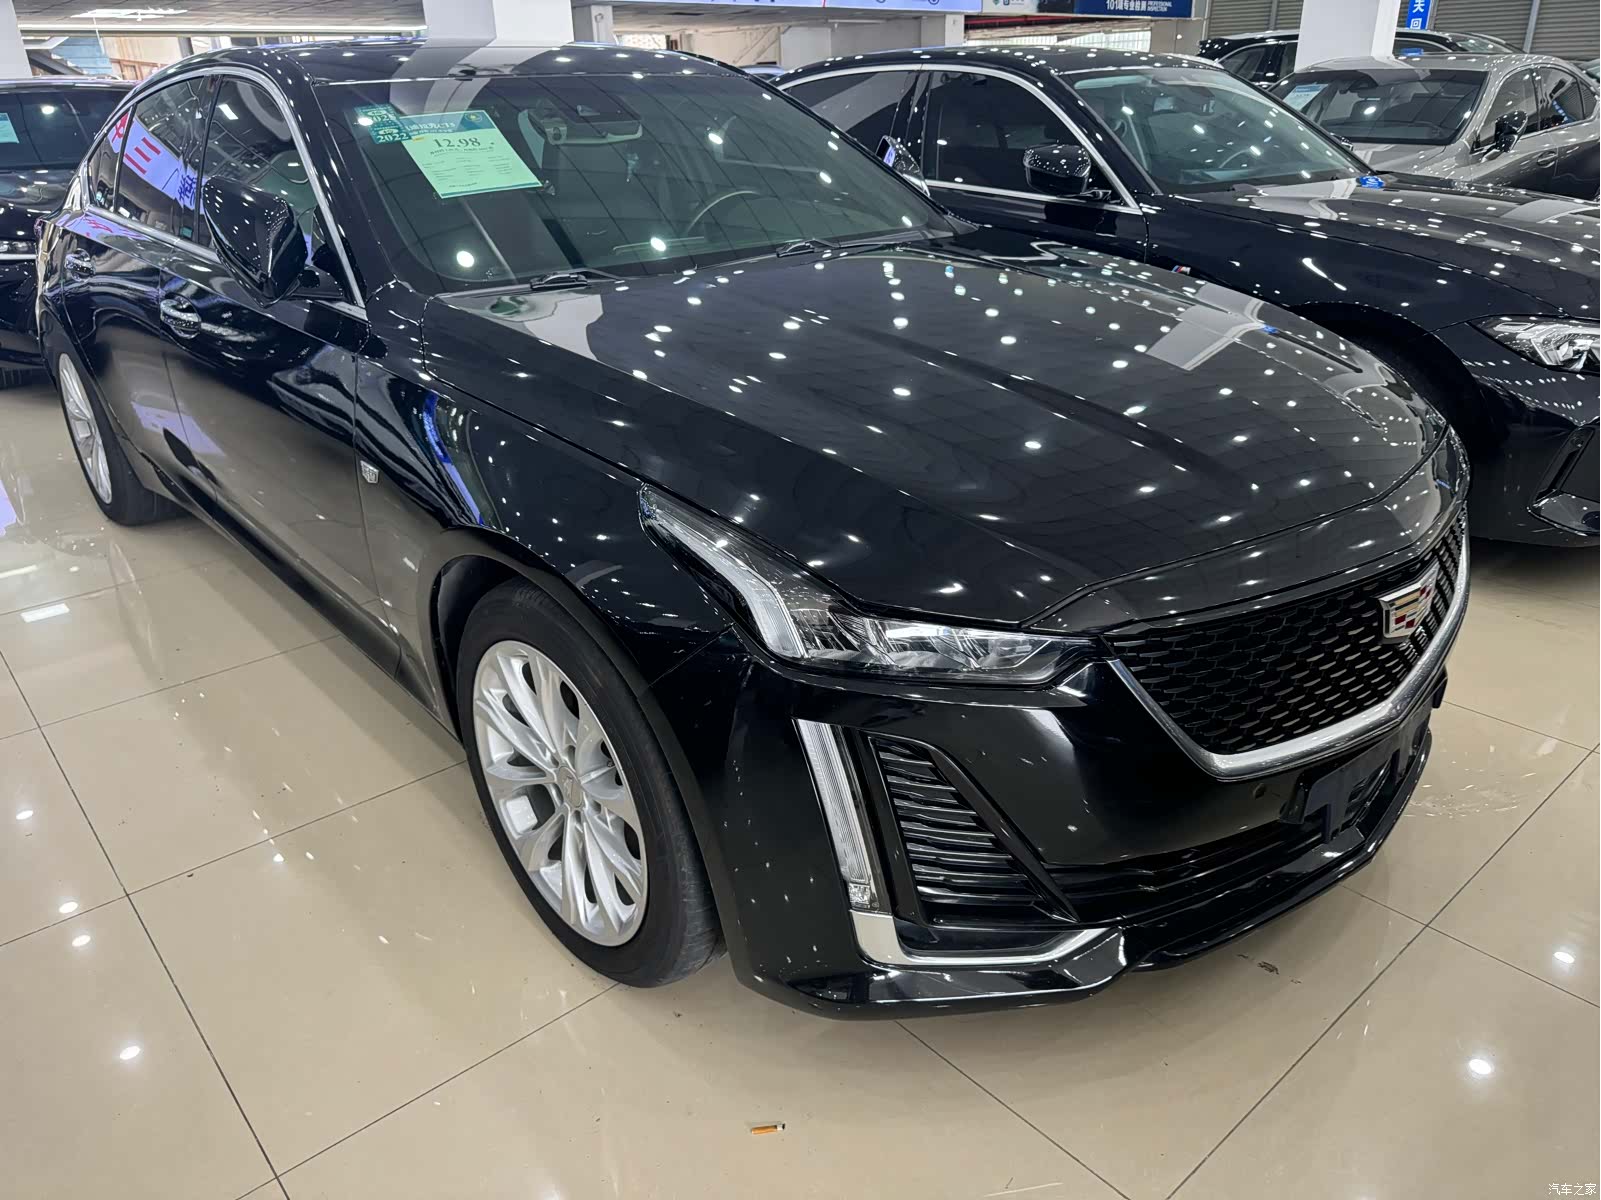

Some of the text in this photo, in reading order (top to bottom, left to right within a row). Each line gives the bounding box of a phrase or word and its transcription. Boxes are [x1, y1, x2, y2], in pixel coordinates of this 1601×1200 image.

[1106, 0, 1147, 11] 101项专业检测
[376, 132, 409, 143] 2022
[433, 137, 481, 148] 12.98
